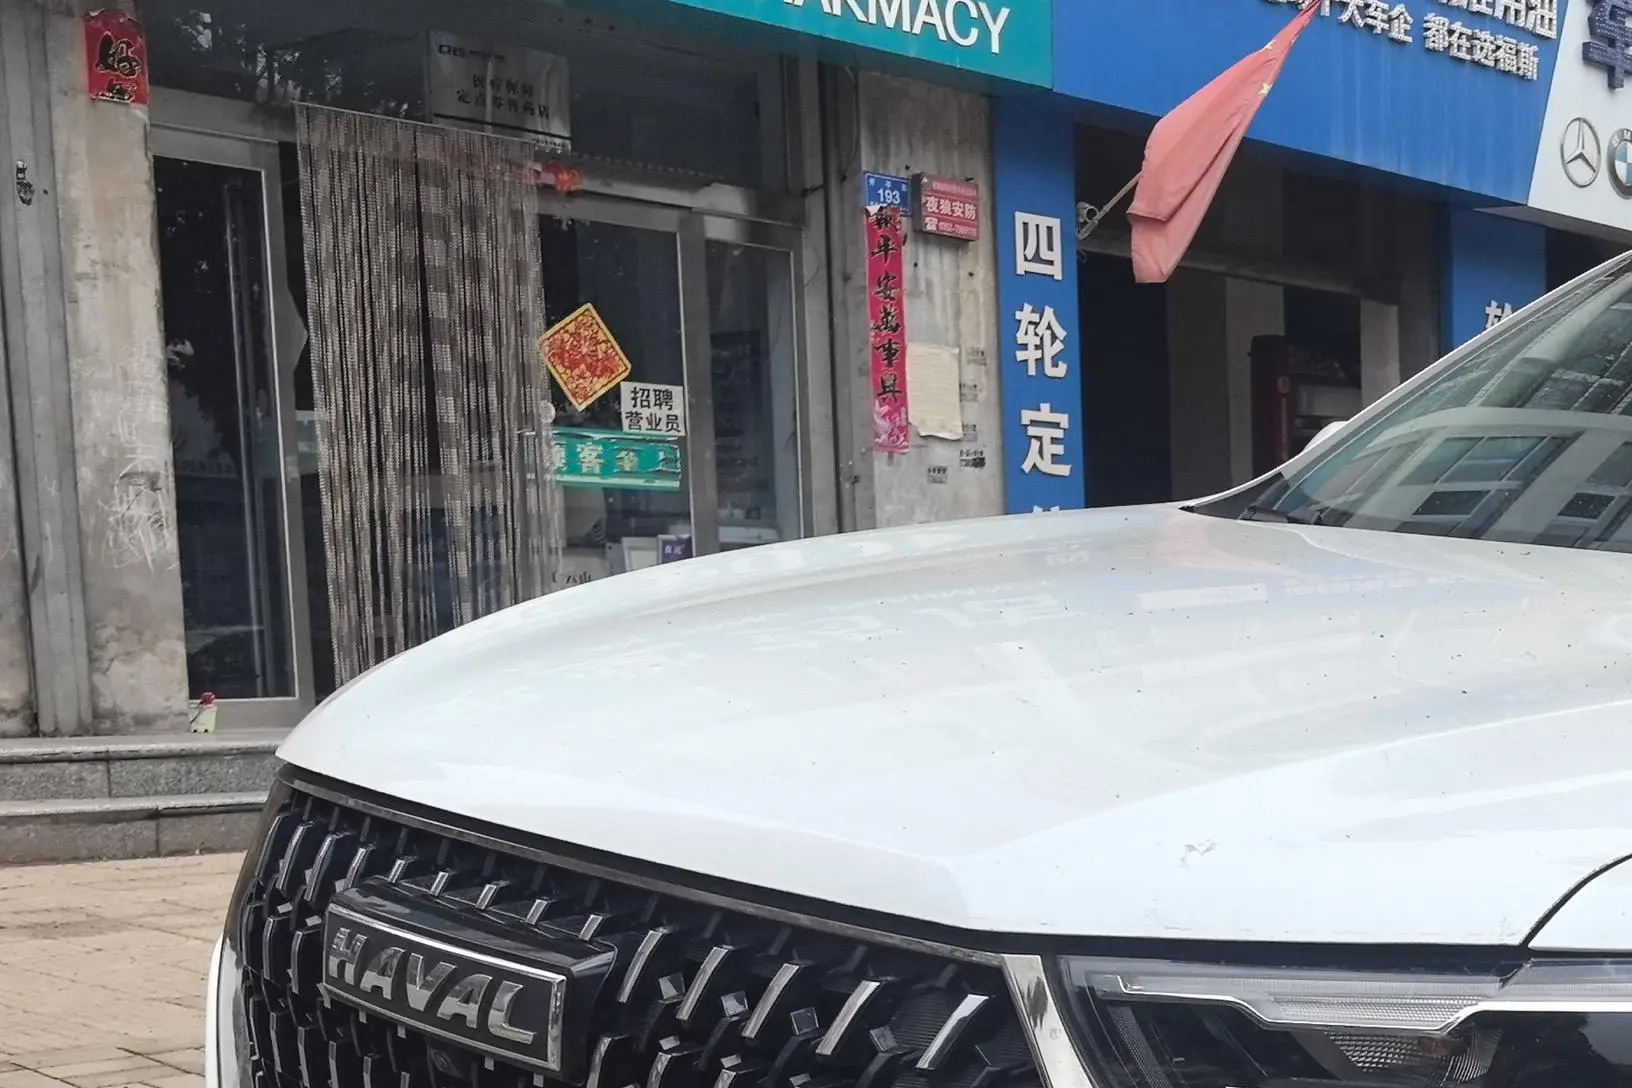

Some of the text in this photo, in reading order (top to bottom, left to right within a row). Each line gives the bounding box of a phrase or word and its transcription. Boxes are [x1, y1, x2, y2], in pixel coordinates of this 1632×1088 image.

[877, 188, 901, 204] 193
[1014, 211, 1072, 514] 四轮定
[630, 386, 674, 411] 招聘
[624, 410, 681, 434] 营业员
[328, 927, 537, 1045] HAVAL
